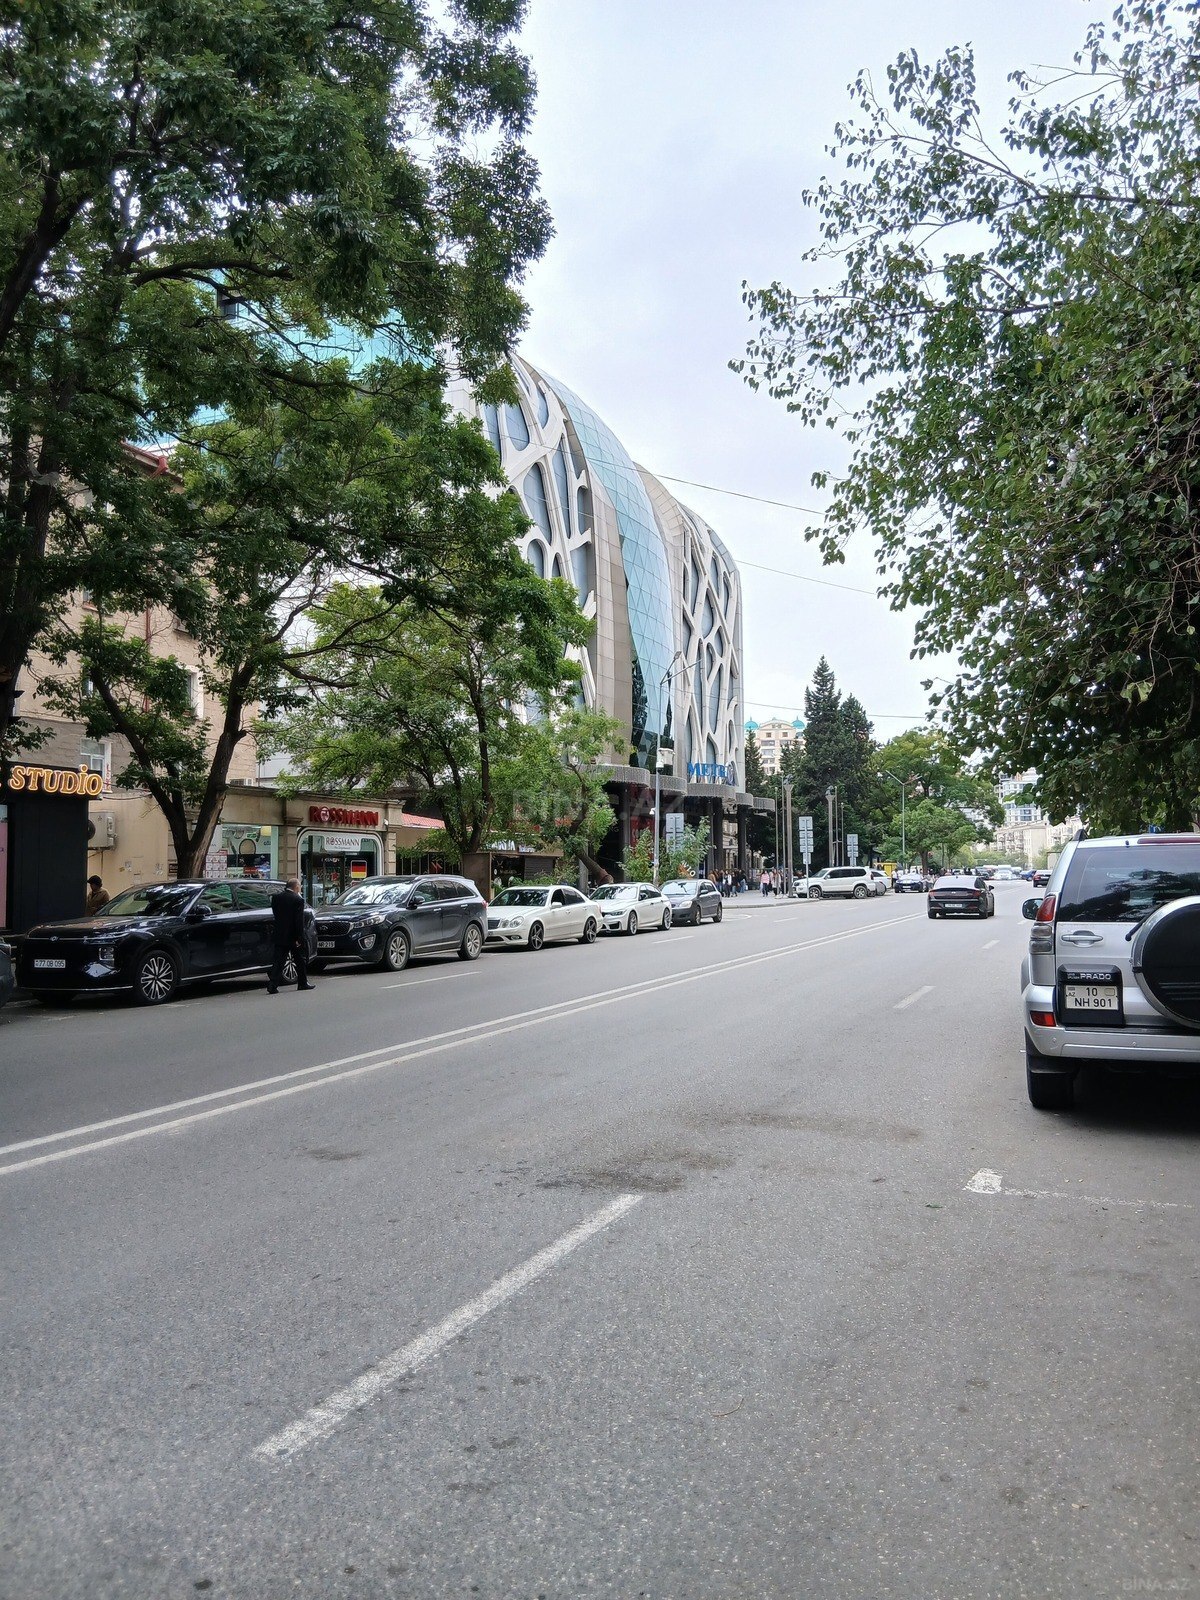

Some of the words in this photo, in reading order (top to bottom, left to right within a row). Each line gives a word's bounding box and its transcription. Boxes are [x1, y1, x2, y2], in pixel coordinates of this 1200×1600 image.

[309, 806, 378, 826] ROSSMANN
[326, 837, 360, 847] ROSSMANN
[1086, 987, 1098, 997] 10
[1075, 997, 1090, 1007] NH
[1093, 998, 1112, 1008] 901
